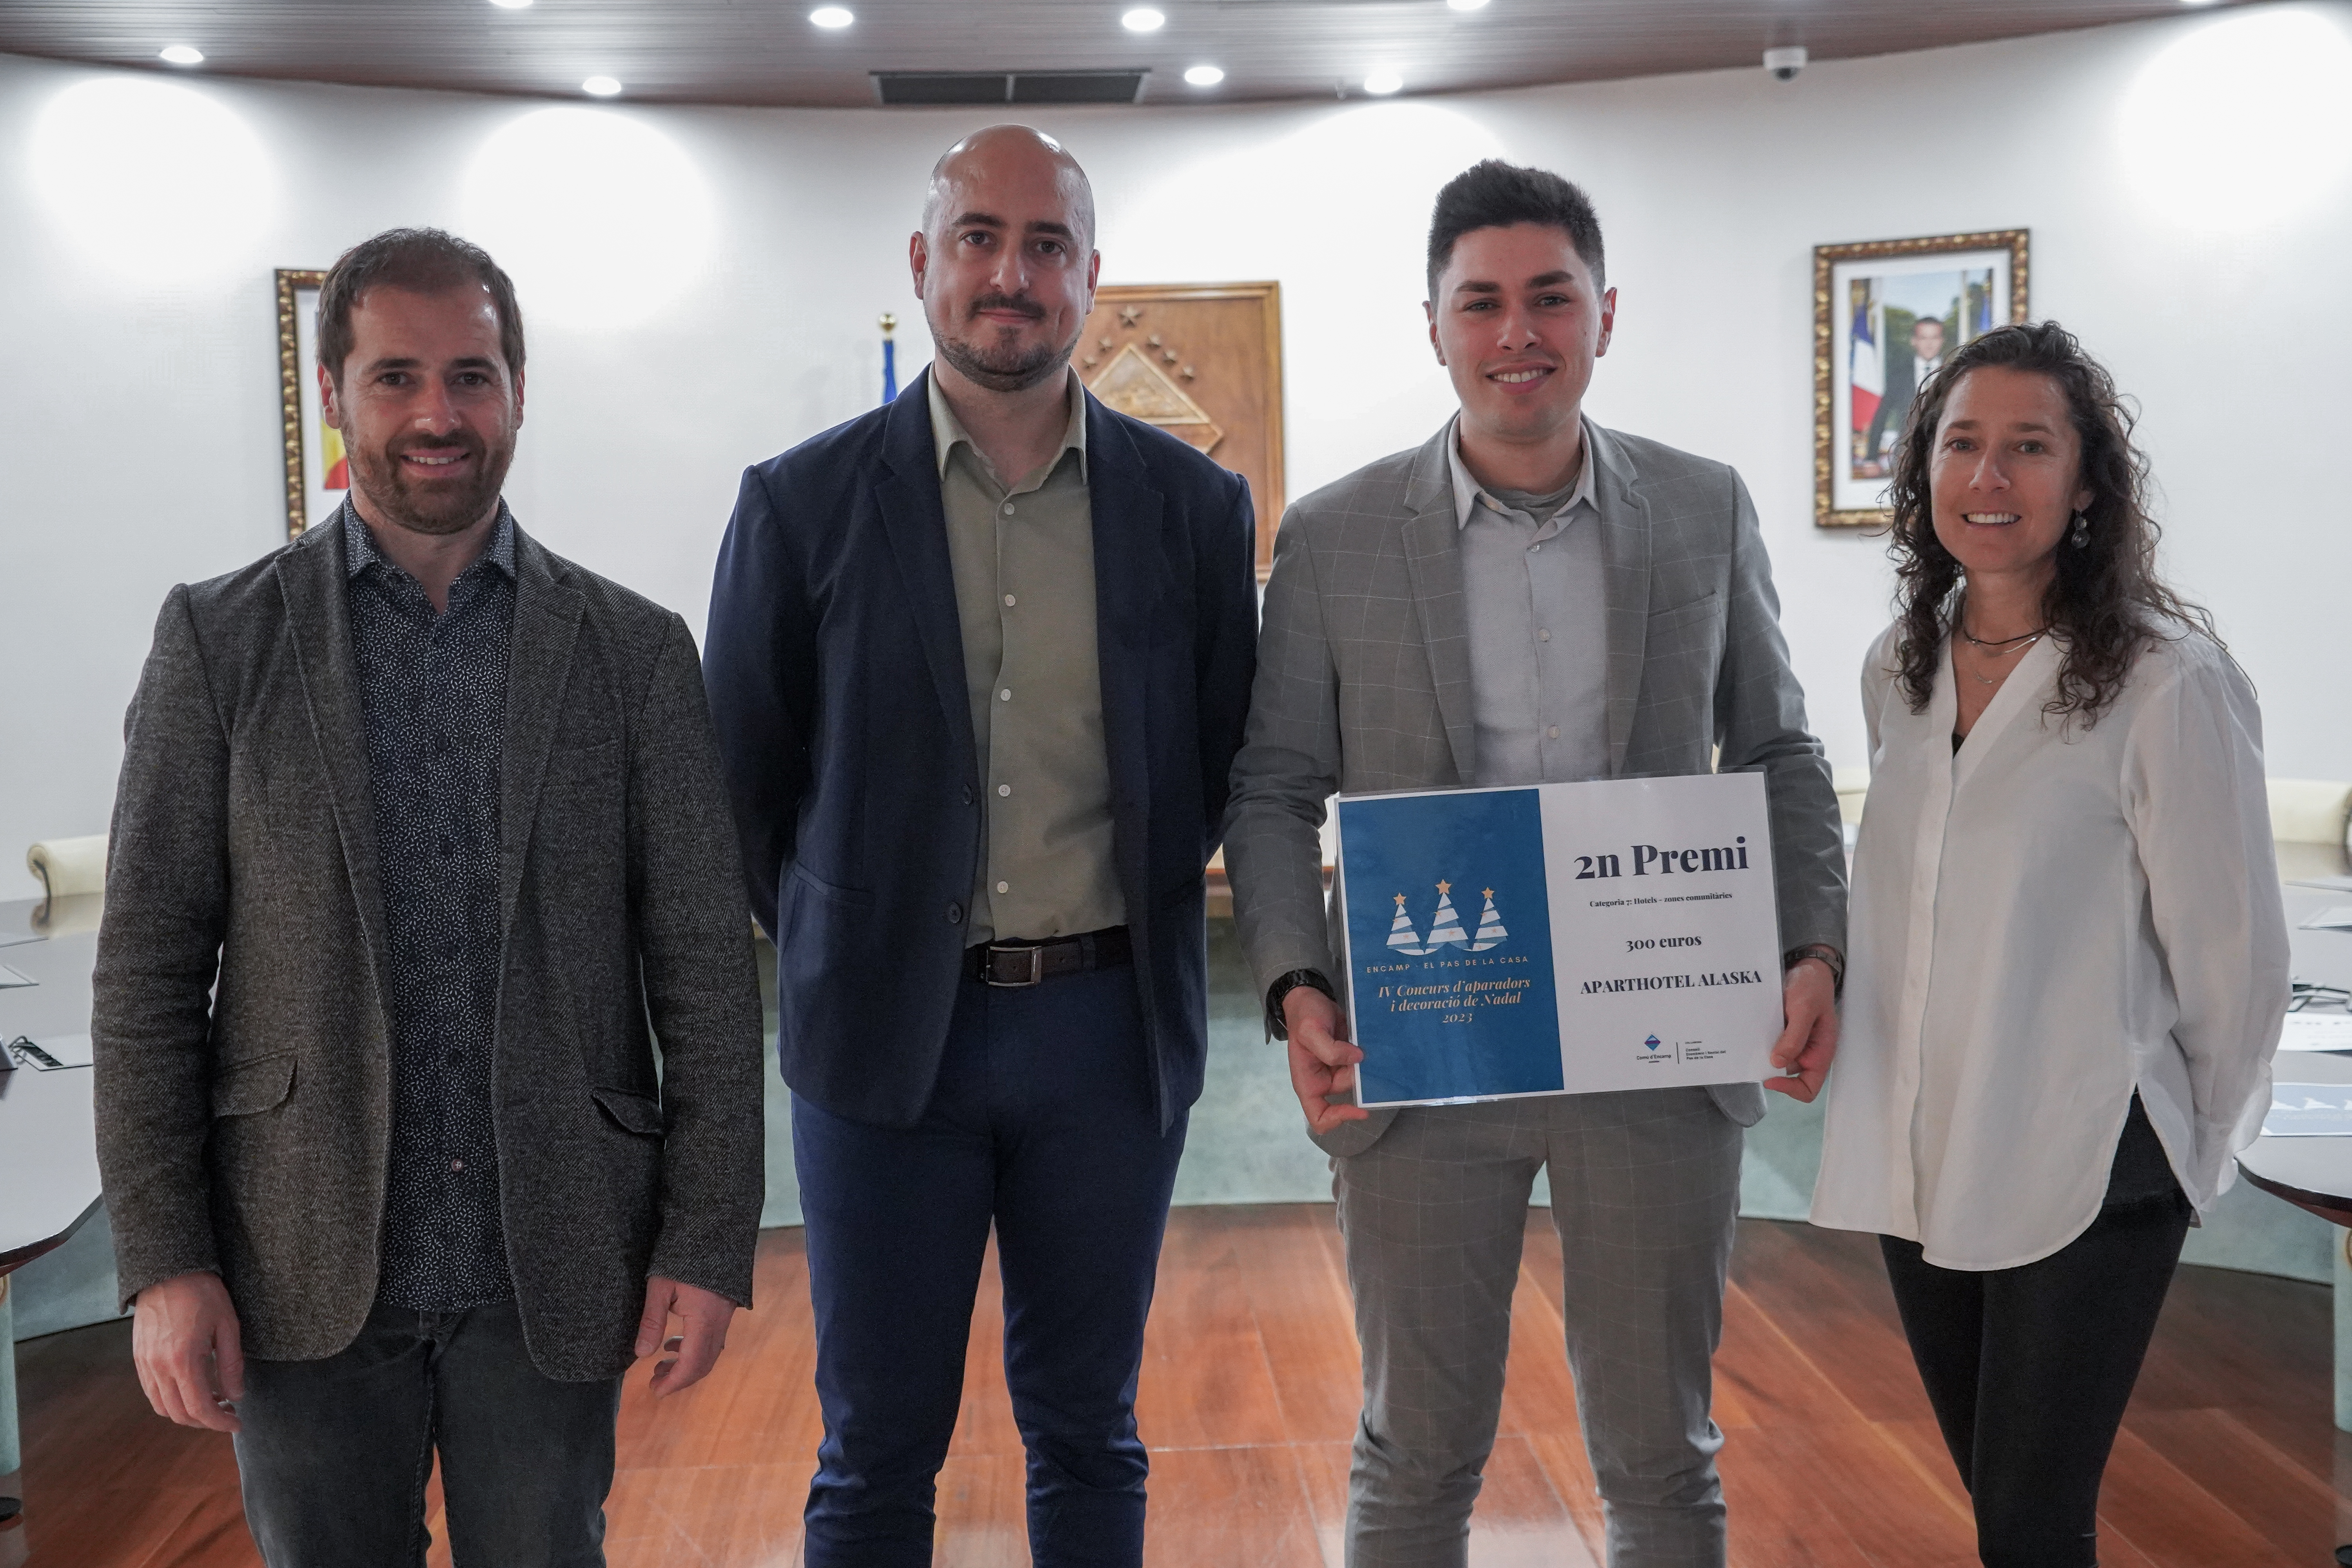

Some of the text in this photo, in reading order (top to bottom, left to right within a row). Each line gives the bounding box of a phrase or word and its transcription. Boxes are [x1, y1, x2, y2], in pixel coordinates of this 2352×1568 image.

[1574, 836, 1749, 880] 2n Premi
[1590, 899, 1624, 907] Categoria
[1686, 892, 1732, 901] comunitàries
[1626, 936, 1702, 953] 300 euros
[1367, 964, 1410, 973] ENCAMP
[1378, 977, 1531, 998] IV Concurs d'aparadors
[1581, 971, 1762, 994] APARTHOTEL ALASKA
[1391, 991, 1521, 1012] i decoració de Nadal
[1442, 1013, 1472, 1023] 2023
